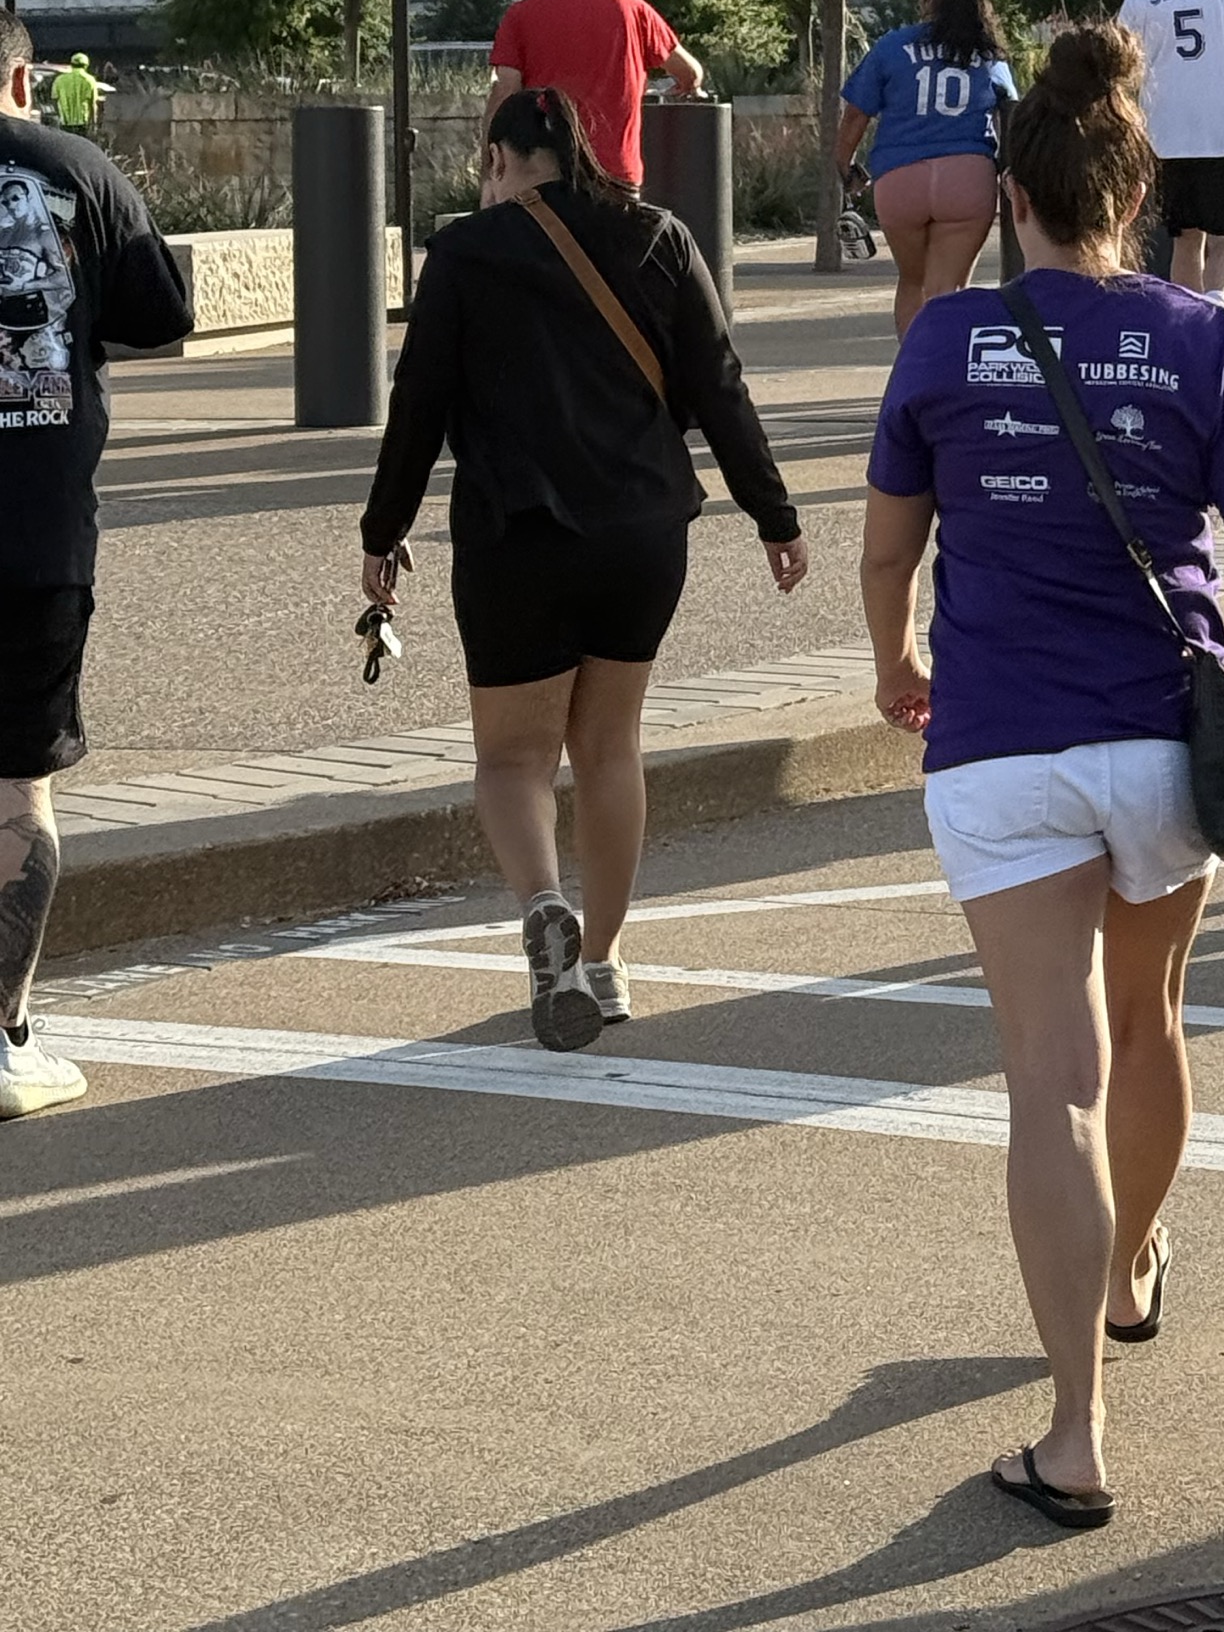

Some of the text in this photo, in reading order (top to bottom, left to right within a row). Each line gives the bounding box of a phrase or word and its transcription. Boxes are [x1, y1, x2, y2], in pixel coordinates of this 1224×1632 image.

[1173, 8, 1205, 60] 5
[915, 65, 970, 117] 10
[968, 362, 1042, 373] PARKWO
[1078, 363, 1179, 390] TUBBESING
[967, 371, 1046, 384] COLLISIO
[0, 409, 69, 428] HE ROCK
[980, 475, 1048, 490] GEICO
